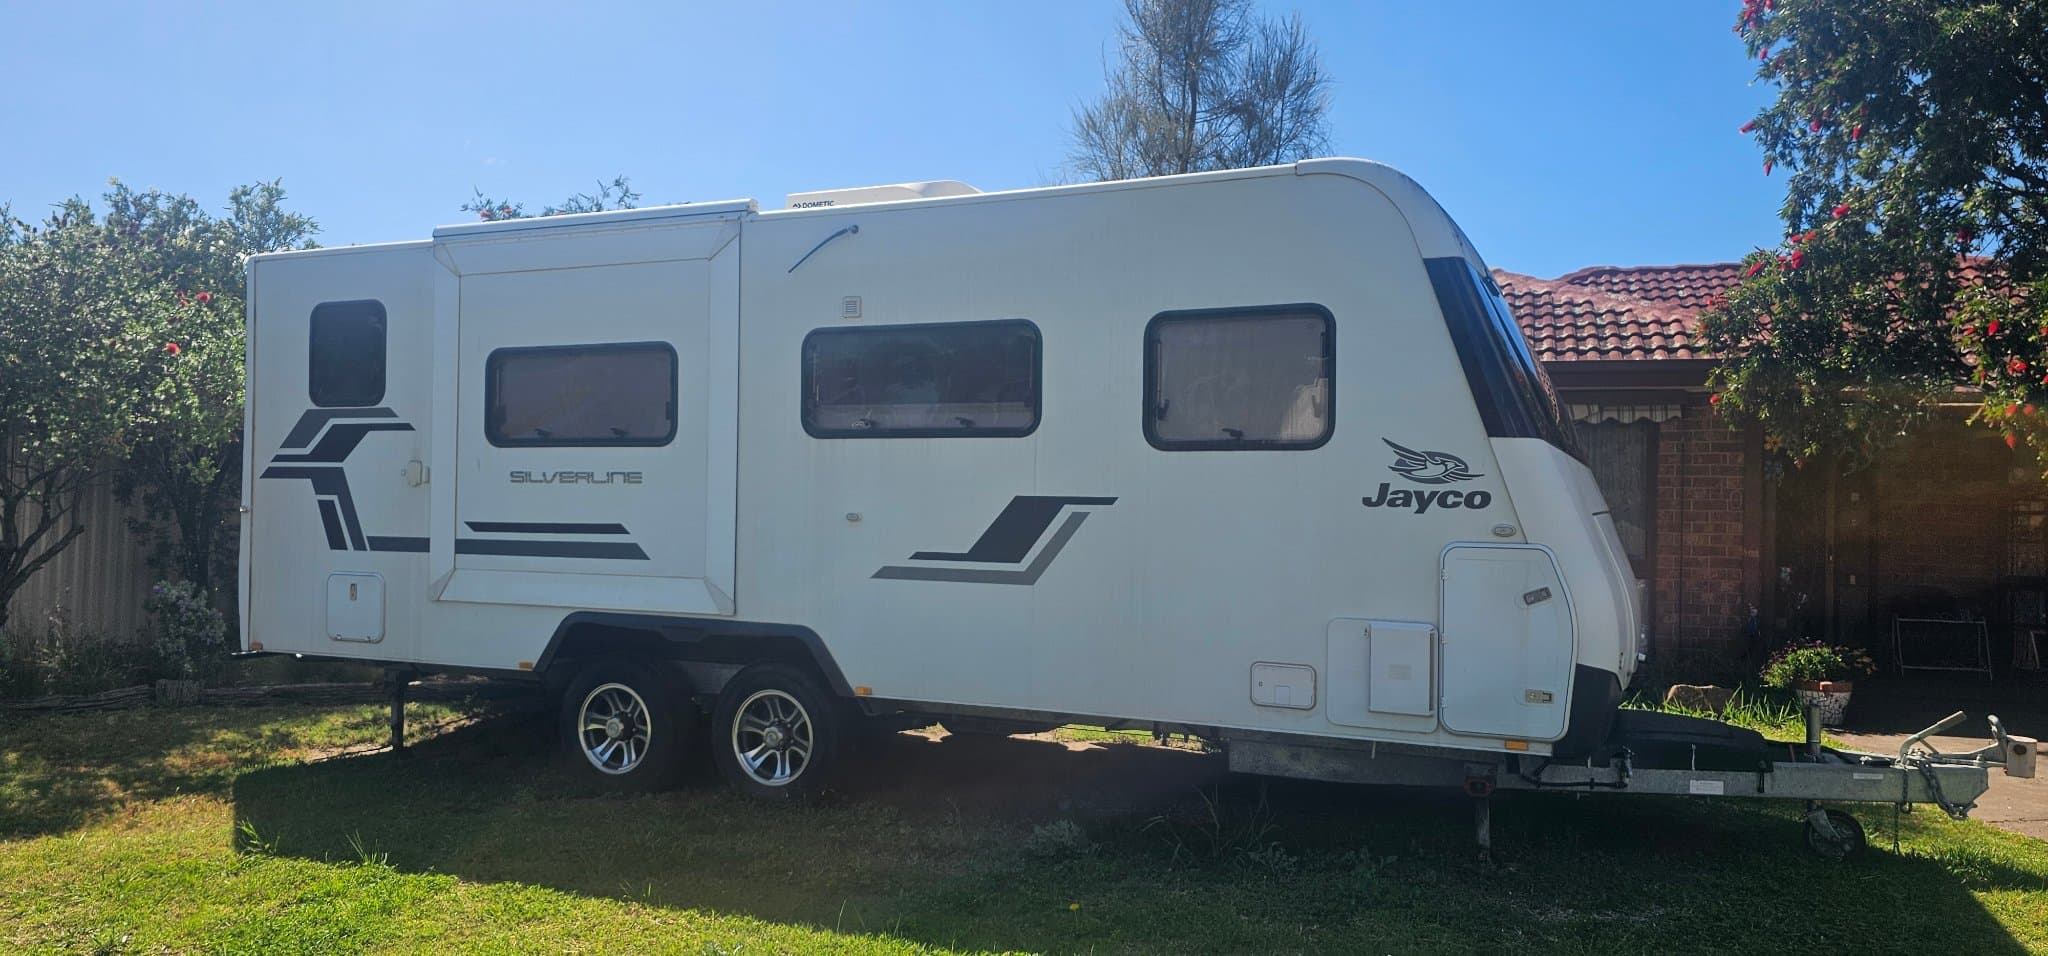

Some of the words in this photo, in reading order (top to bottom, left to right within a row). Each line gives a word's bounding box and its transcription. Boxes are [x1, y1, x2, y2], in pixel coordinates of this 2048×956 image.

[802, 200, 834, 208] DOMETIC
[510, 471, 643, 484] SILVERLINE
[1362, 482, 1492, 514] Jayco
